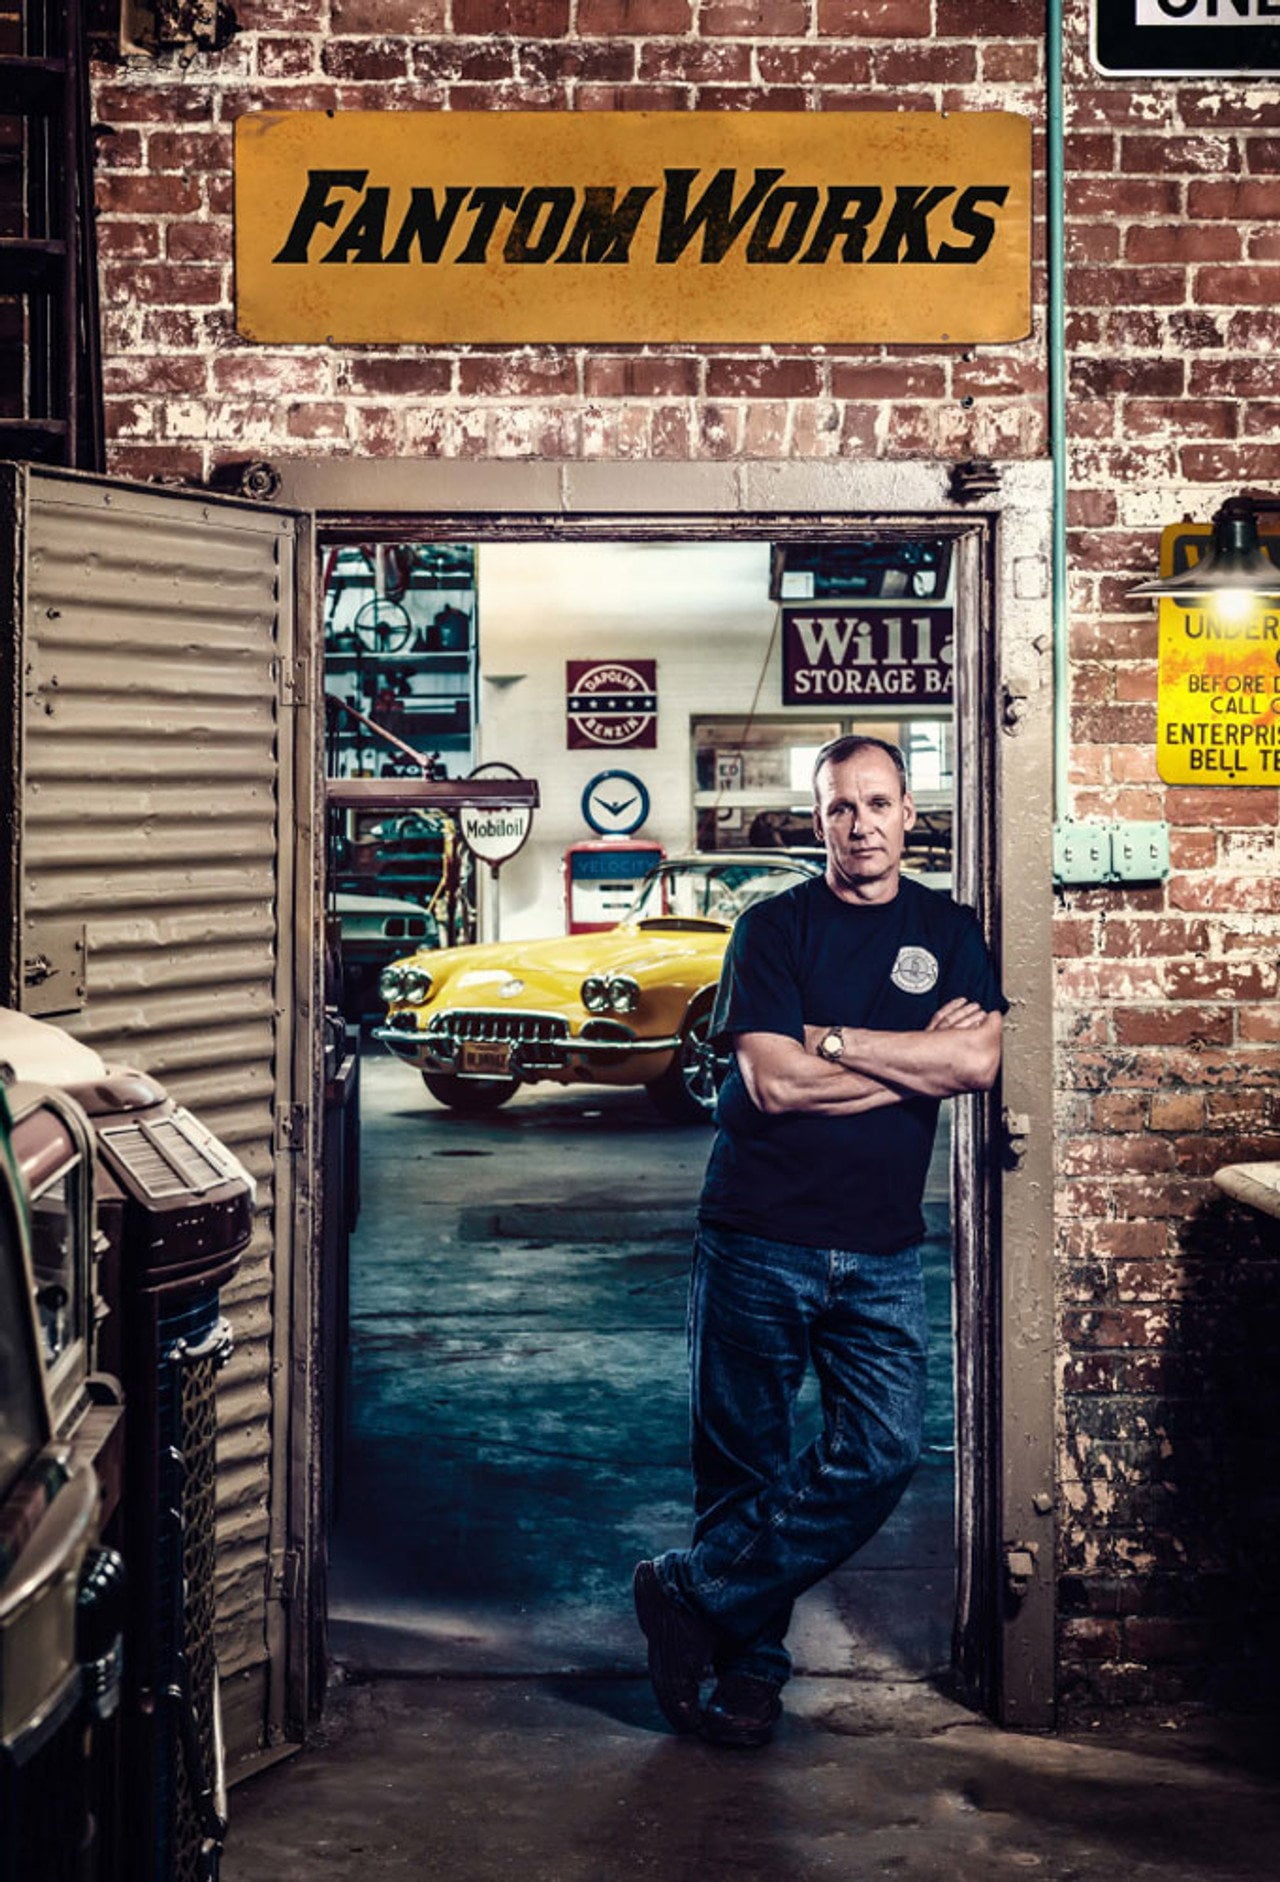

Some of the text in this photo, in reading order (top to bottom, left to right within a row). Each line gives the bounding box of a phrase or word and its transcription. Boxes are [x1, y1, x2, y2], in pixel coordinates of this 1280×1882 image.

[795, 669, 917, 694] STORAGE
[1189, 674, 1266, 694] BEFORE
[1210, 696, 1261, 714] CALL
[1166, 723, 1280, 746] ENTERPRI
[1190, 749, 1248, 771] BELL
[466, 817, 523, 839] Mobiloil
